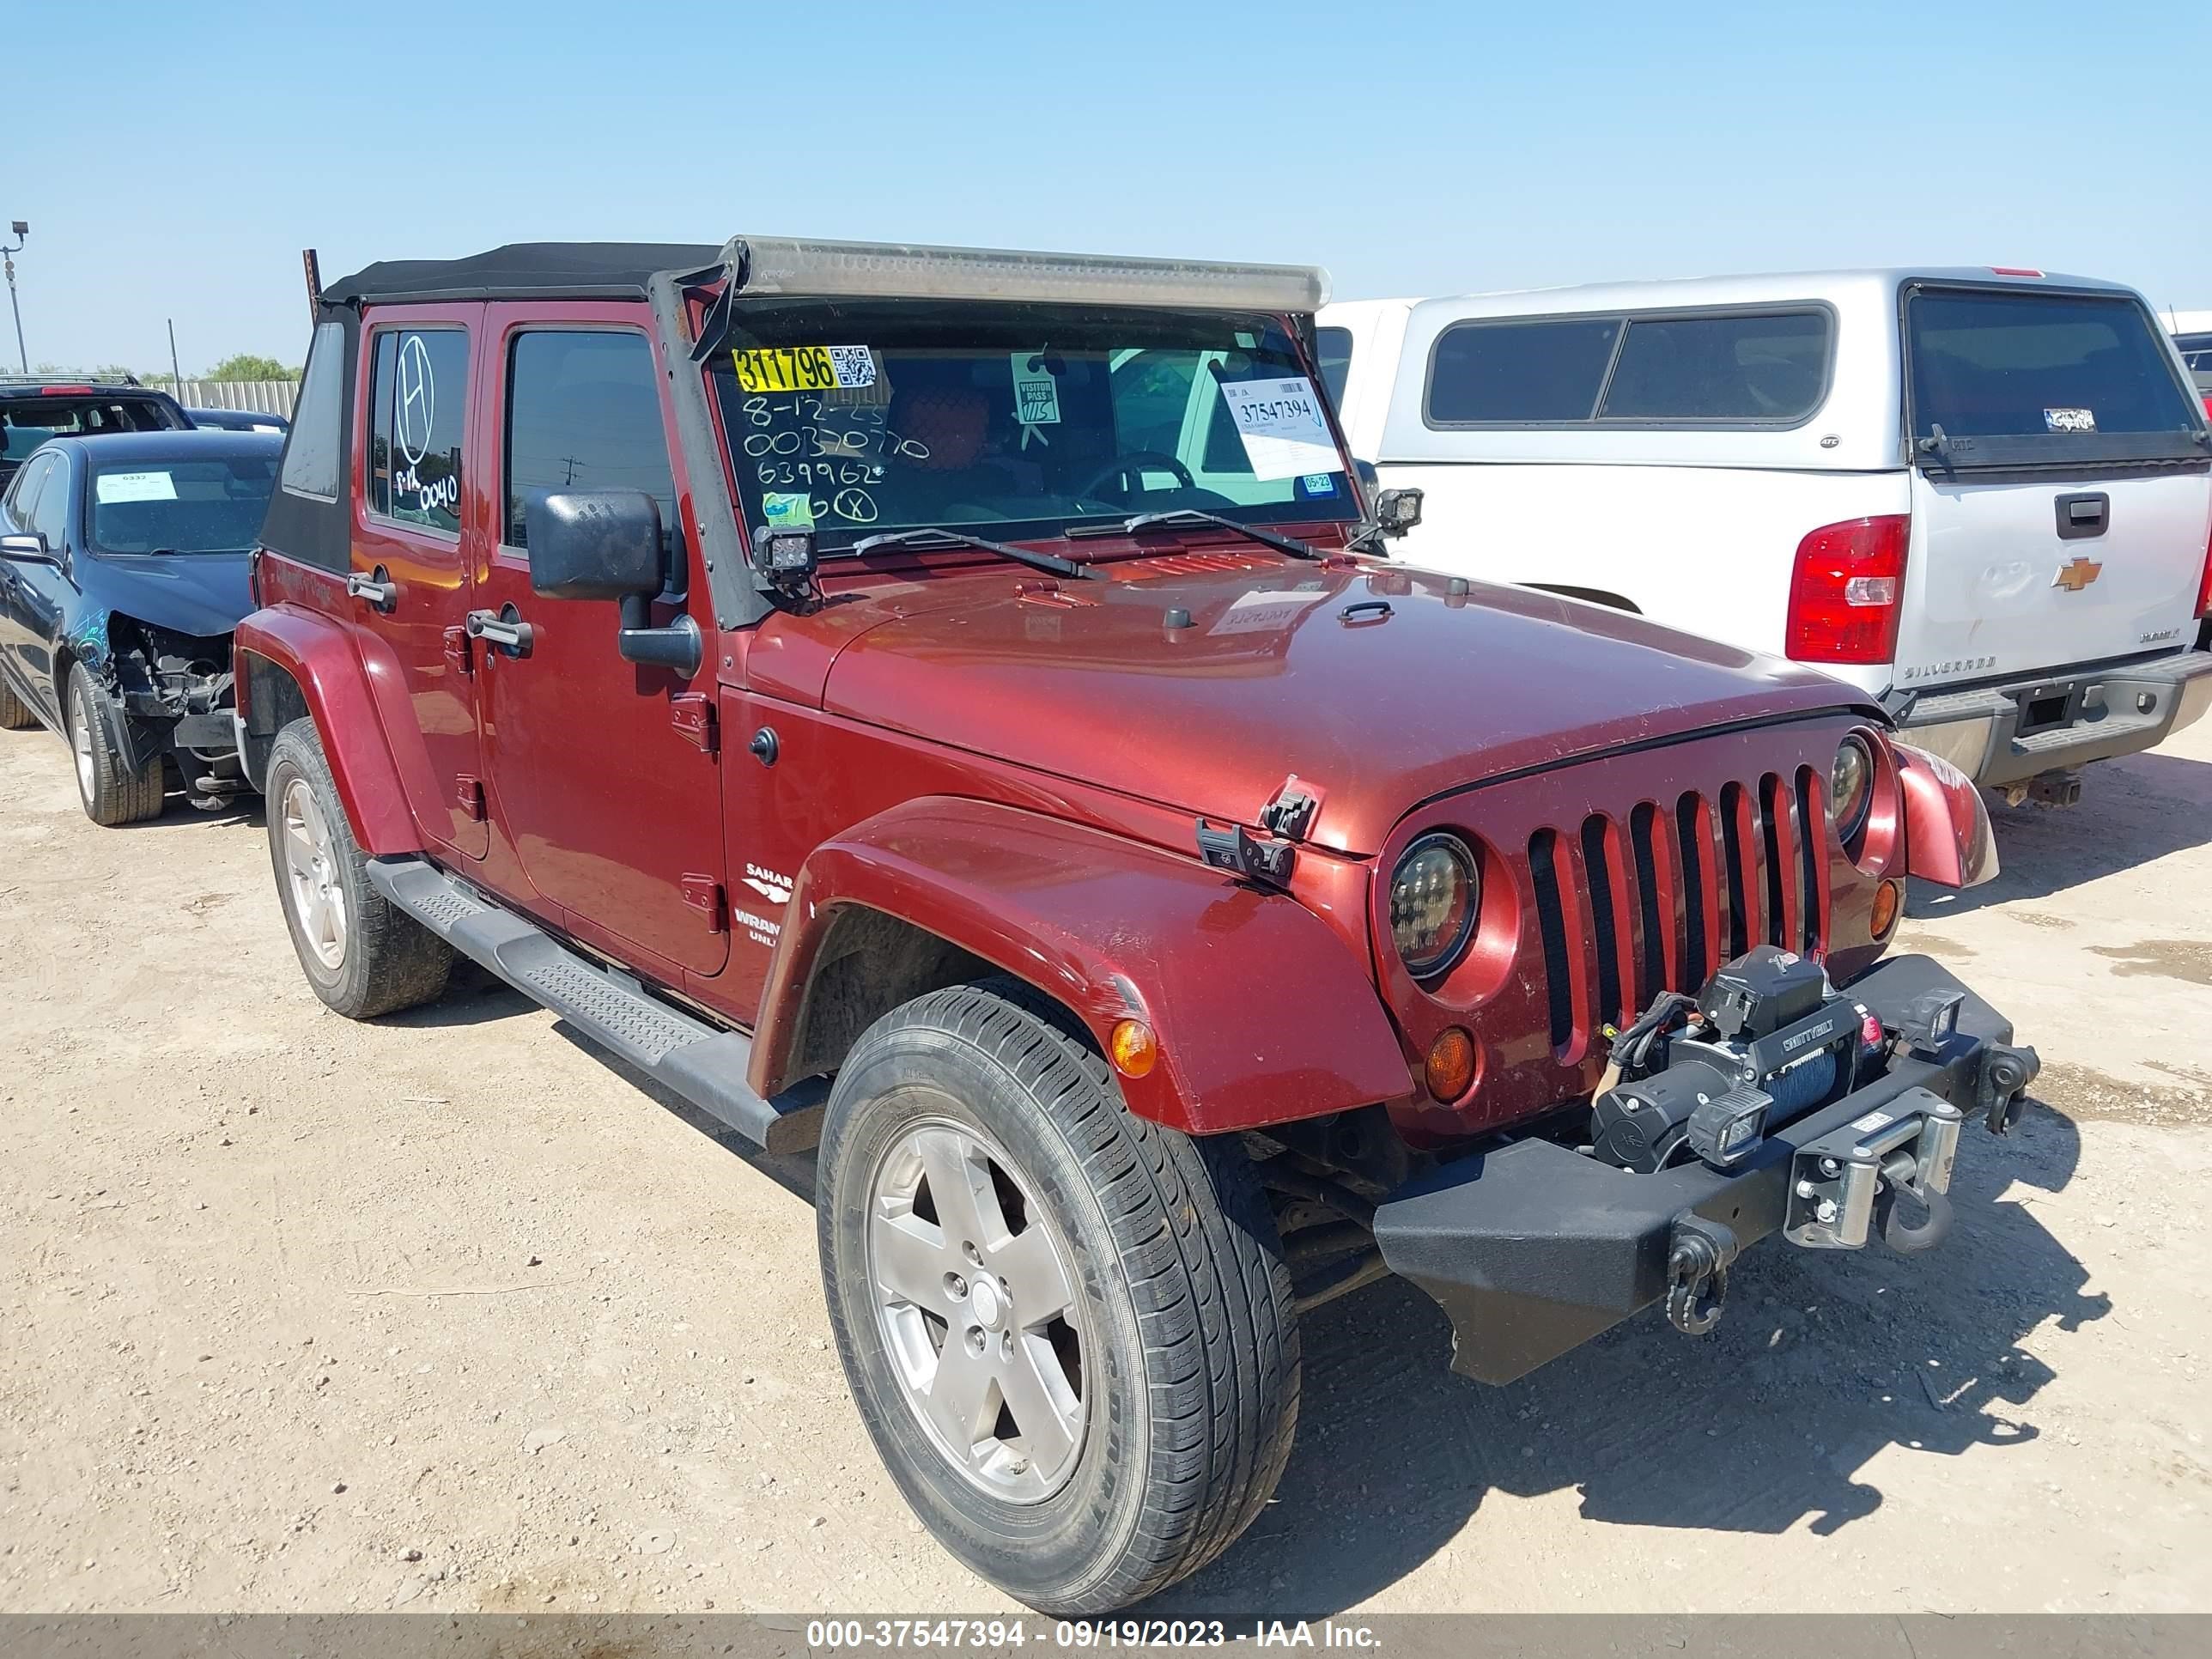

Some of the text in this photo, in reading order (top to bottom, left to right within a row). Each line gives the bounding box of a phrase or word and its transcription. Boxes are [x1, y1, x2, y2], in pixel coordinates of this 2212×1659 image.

[738, 348, 835, 389] 311796
[1020, 383, 1052, 392] VISITOR
[1027, 392, 1047, 401] PASS
[1241, 398, 1311, 422] 37547394
[420, 475, 458, 510] 0040
[1904, 656, 1996, 679] SILVERADO
[746, 862, 793, 889] SAHAR
[734, 907, 781, 935] WRAN
